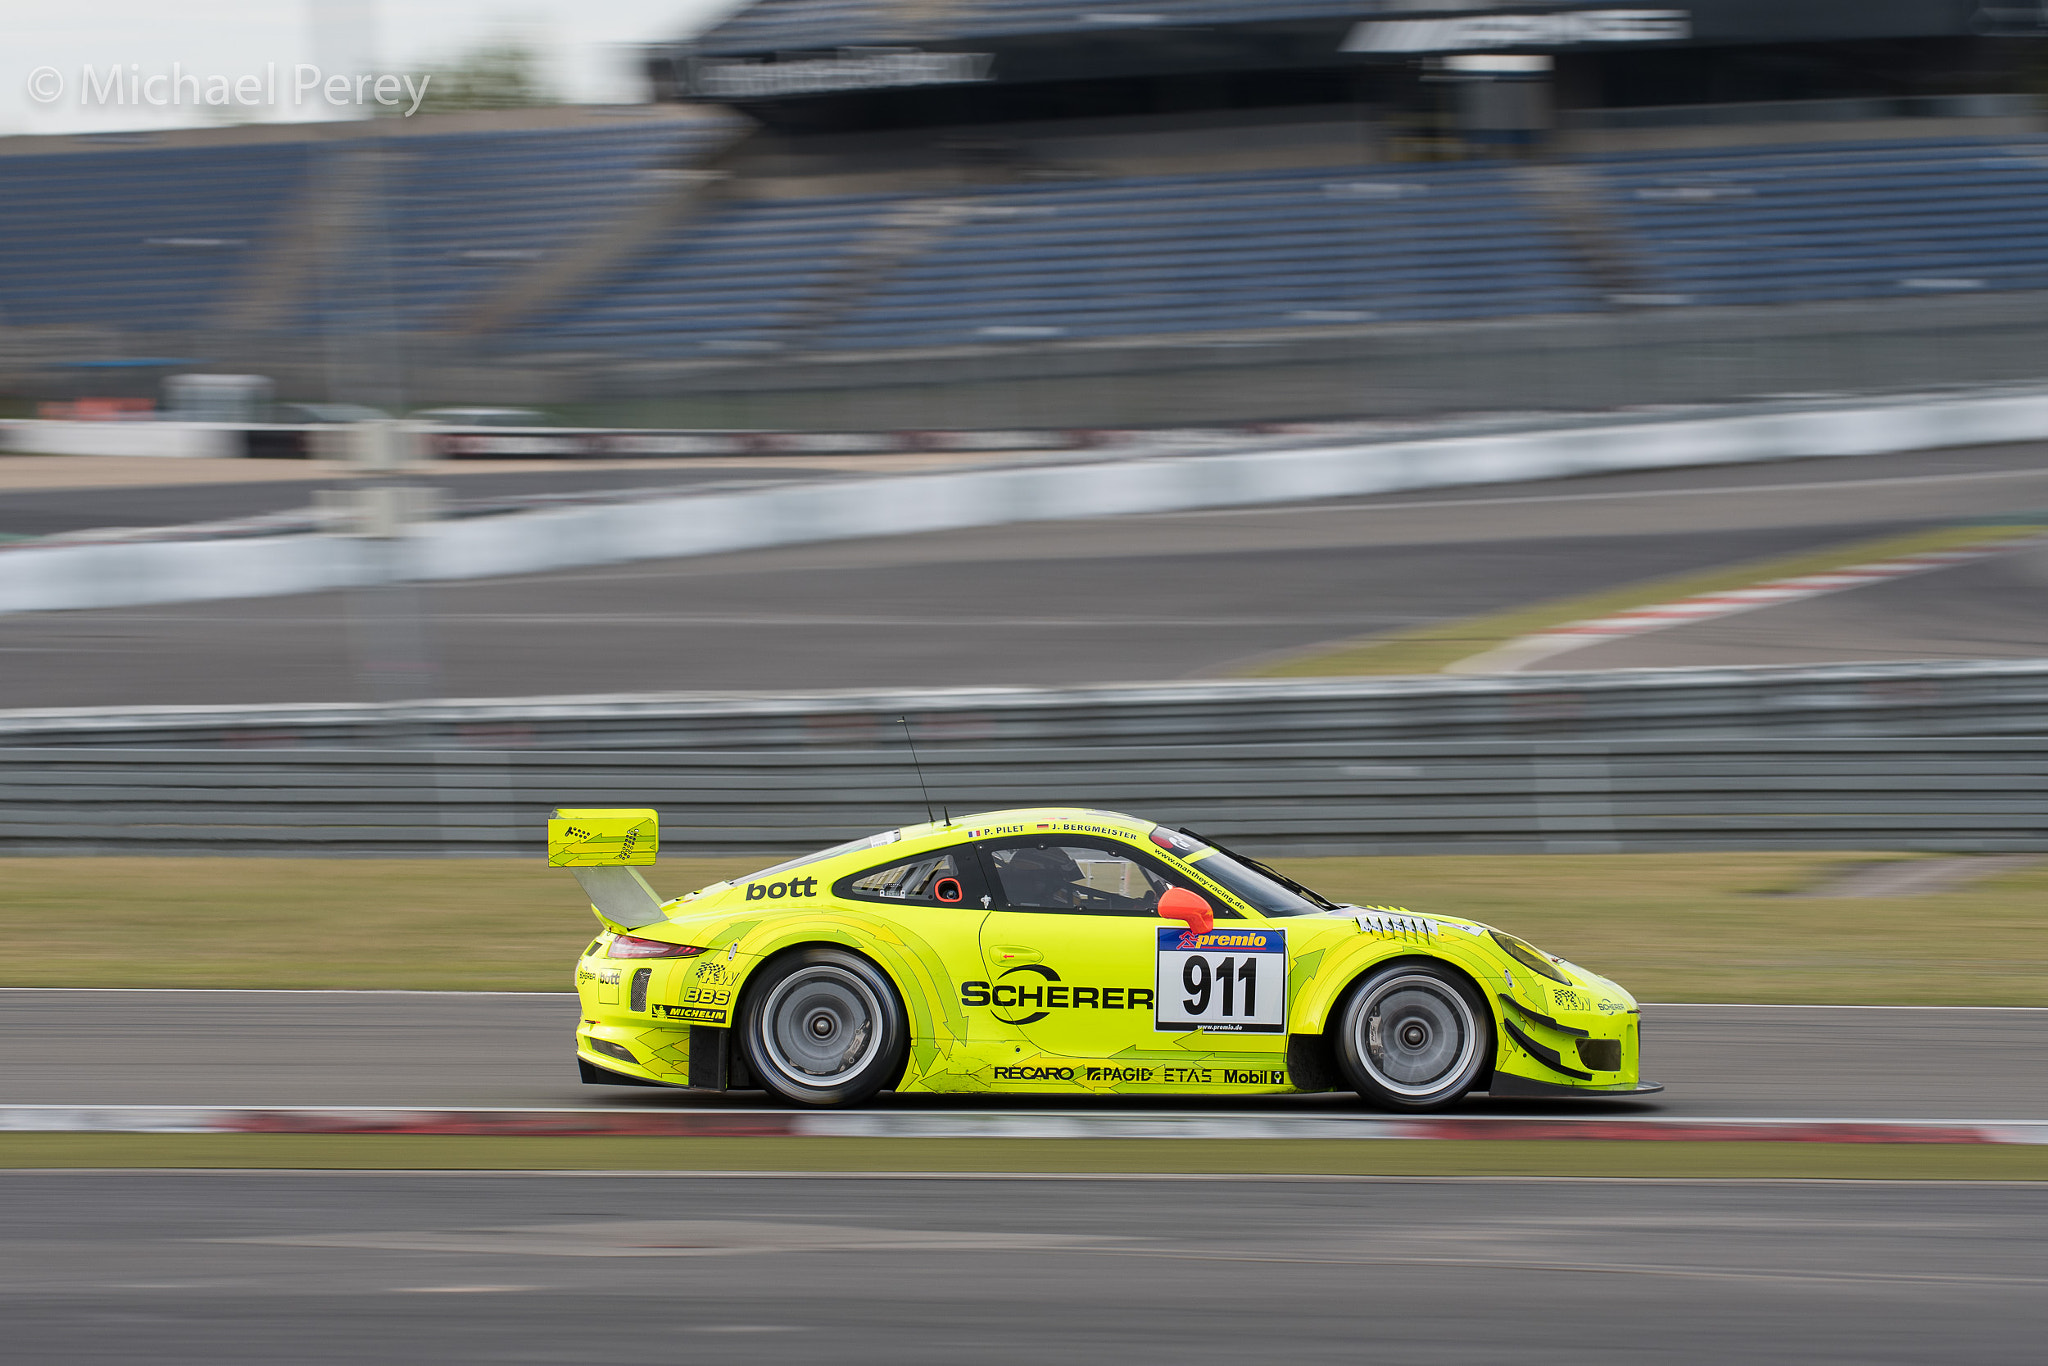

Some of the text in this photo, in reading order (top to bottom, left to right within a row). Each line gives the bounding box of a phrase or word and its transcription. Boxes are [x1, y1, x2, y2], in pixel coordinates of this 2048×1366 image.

[984, 824, 1024, 836] P. PILET
[1063, 824, 1137, 840] BERGMEISTER
[1154, 848, 1245, 911] www.manthey-racing.de
[745, 876, 818, 901] bott
[1195, 933, 1267, 949] premio
[600, 972, 620, 985] bott
[1183, 954, 1257, 1017] 911
[684, 986, 730, 1005] BBS
[961, 981, 1154, 1010] SCHERER
[669, 1007, 725, 1019] MICHELIN
[994, 1066, 1074, 1080] RECARO
[1103, 1067, 1151, 1081] PAGID
[1164, 1068, 1212, 1082] ETAS
[1224, 1069, 1268, 1084] Mobil
